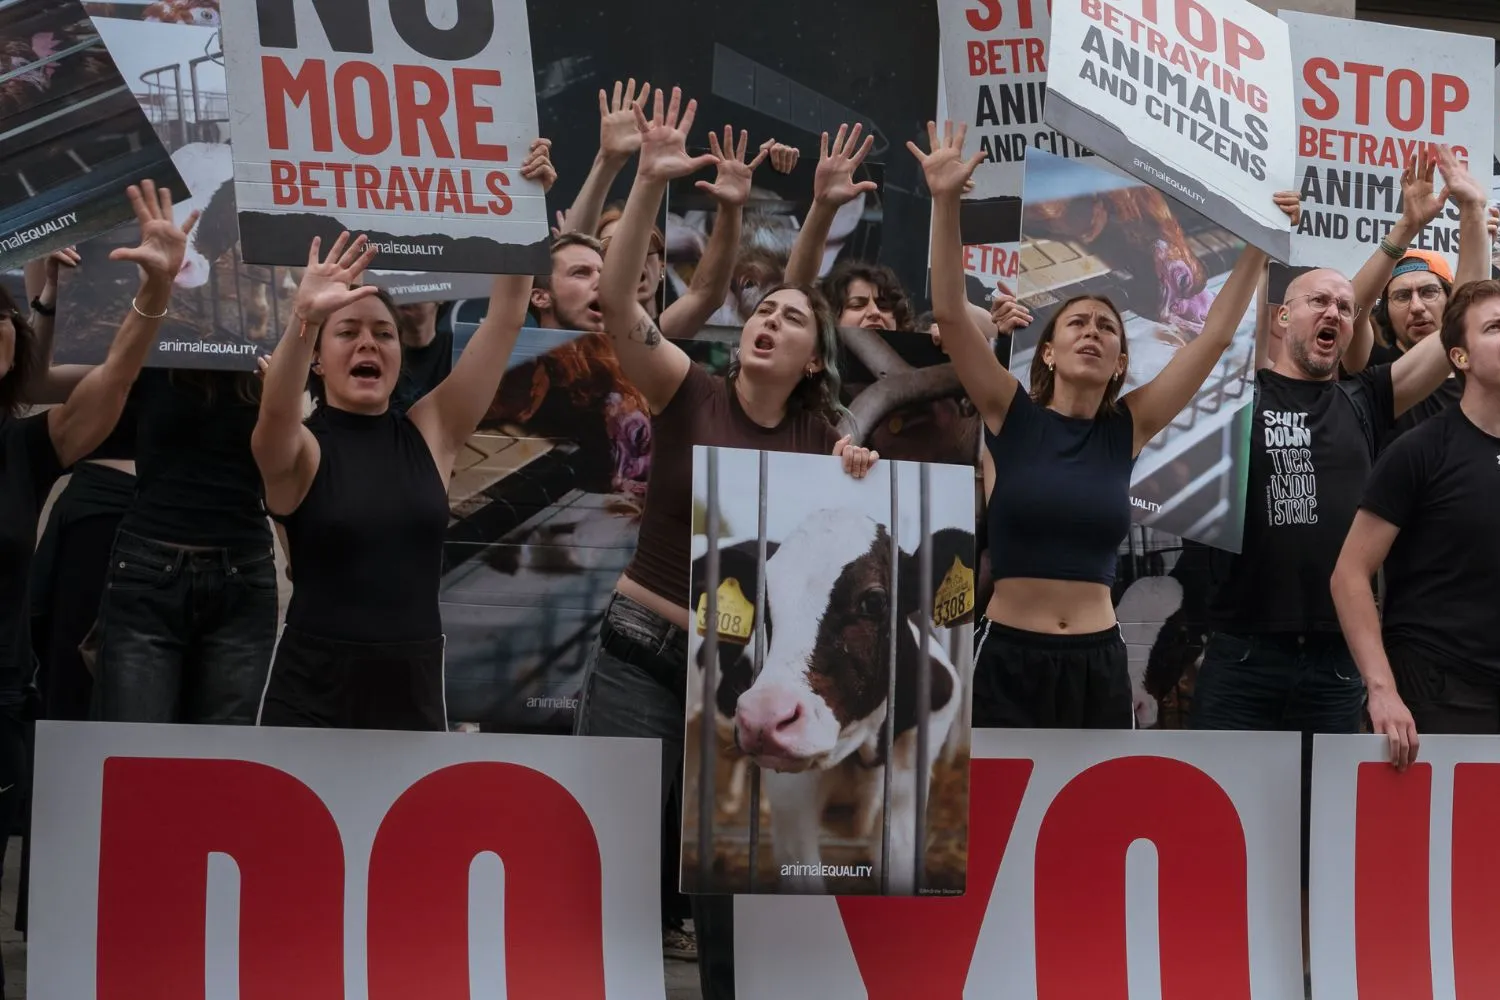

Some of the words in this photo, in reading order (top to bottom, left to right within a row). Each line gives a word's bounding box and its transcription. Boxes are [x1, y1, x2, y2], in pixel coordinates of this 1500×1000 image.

[1081, 0, 1268, 114] BETRAYING
[260, 55, 508, 162] MORE
[975, 81, 1046, 127] ANI
[1081, 24, 1269, 151] ANIMALS
[1302, 56, 1470, 136] STOP
[1078, 59, 1138, 107] AND
[1145, 94, 1267, 182] CITIZENS
[979, 132, 1027, 164] AND
[270, 159, 513, 216] BETRAYALS
[1133, 156, 1207, 204] animalEQUALITY
[1299, 165, 1461, 222] ANIMS
[360, 239, 444, 255] nimalEQUALITY
[1296, 209, 1349, 240] AND
[1355, 216, 1461, 254] CITENS
[159, 338, 258, 355] animalEQUALITY
[1263, 410, 1309, 428] SHUT
[1264, 426, 1311, 447] DOWN
[934, 591, 965, 626] 3308
[96, 755, 606, 1000] DO
[780, 860, 873, 877] animalEQUALITY
